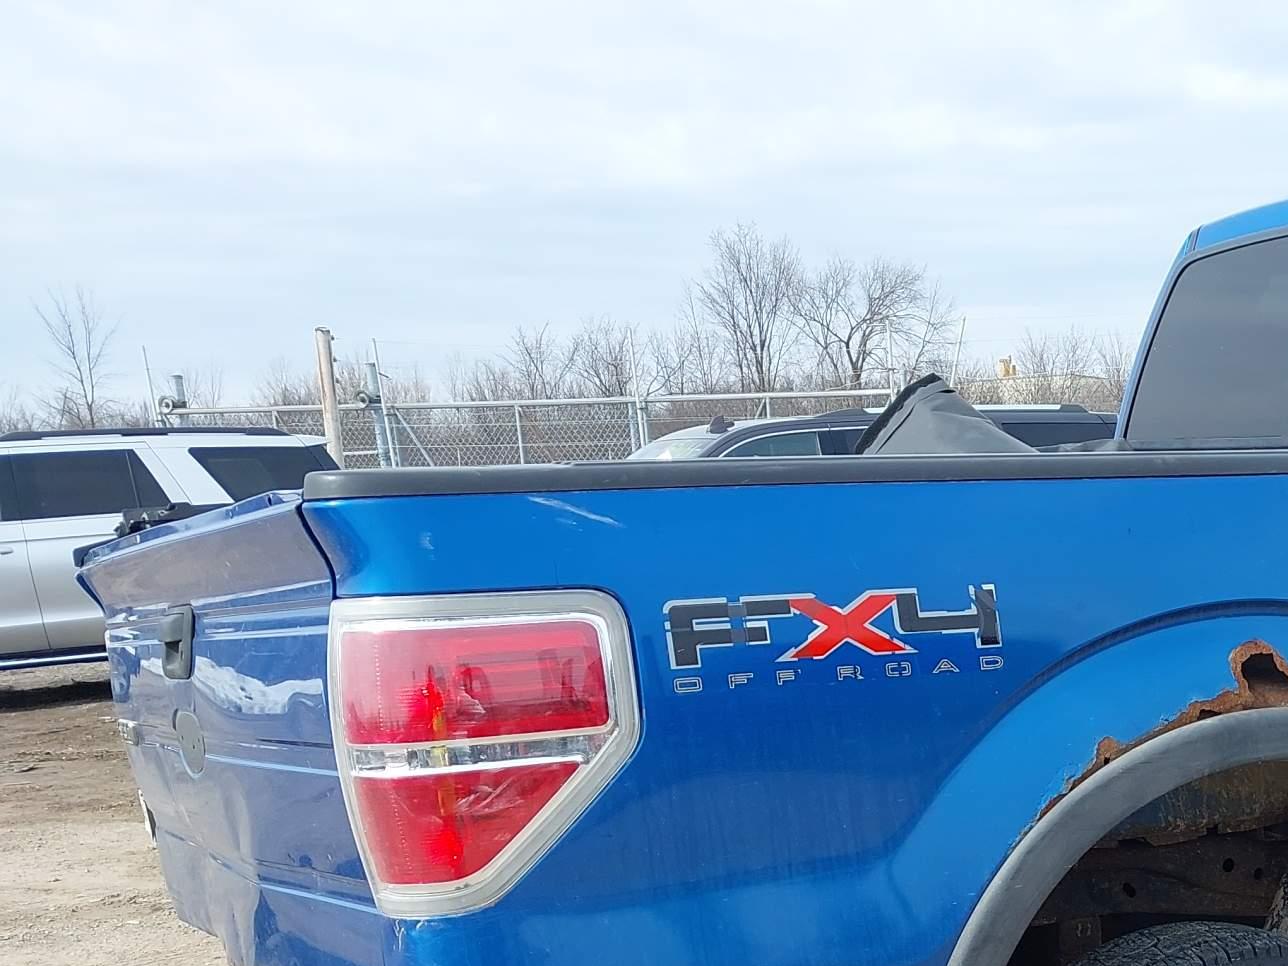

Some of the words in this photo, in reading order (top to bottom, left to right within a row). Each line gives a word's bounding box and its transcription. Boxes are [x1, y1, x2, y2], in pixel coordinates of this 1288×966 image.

[662, 583, 1003, 669] FX4
[673, 669, 801, 693] OFF
[837, 655, 1004, 681] ROAD
